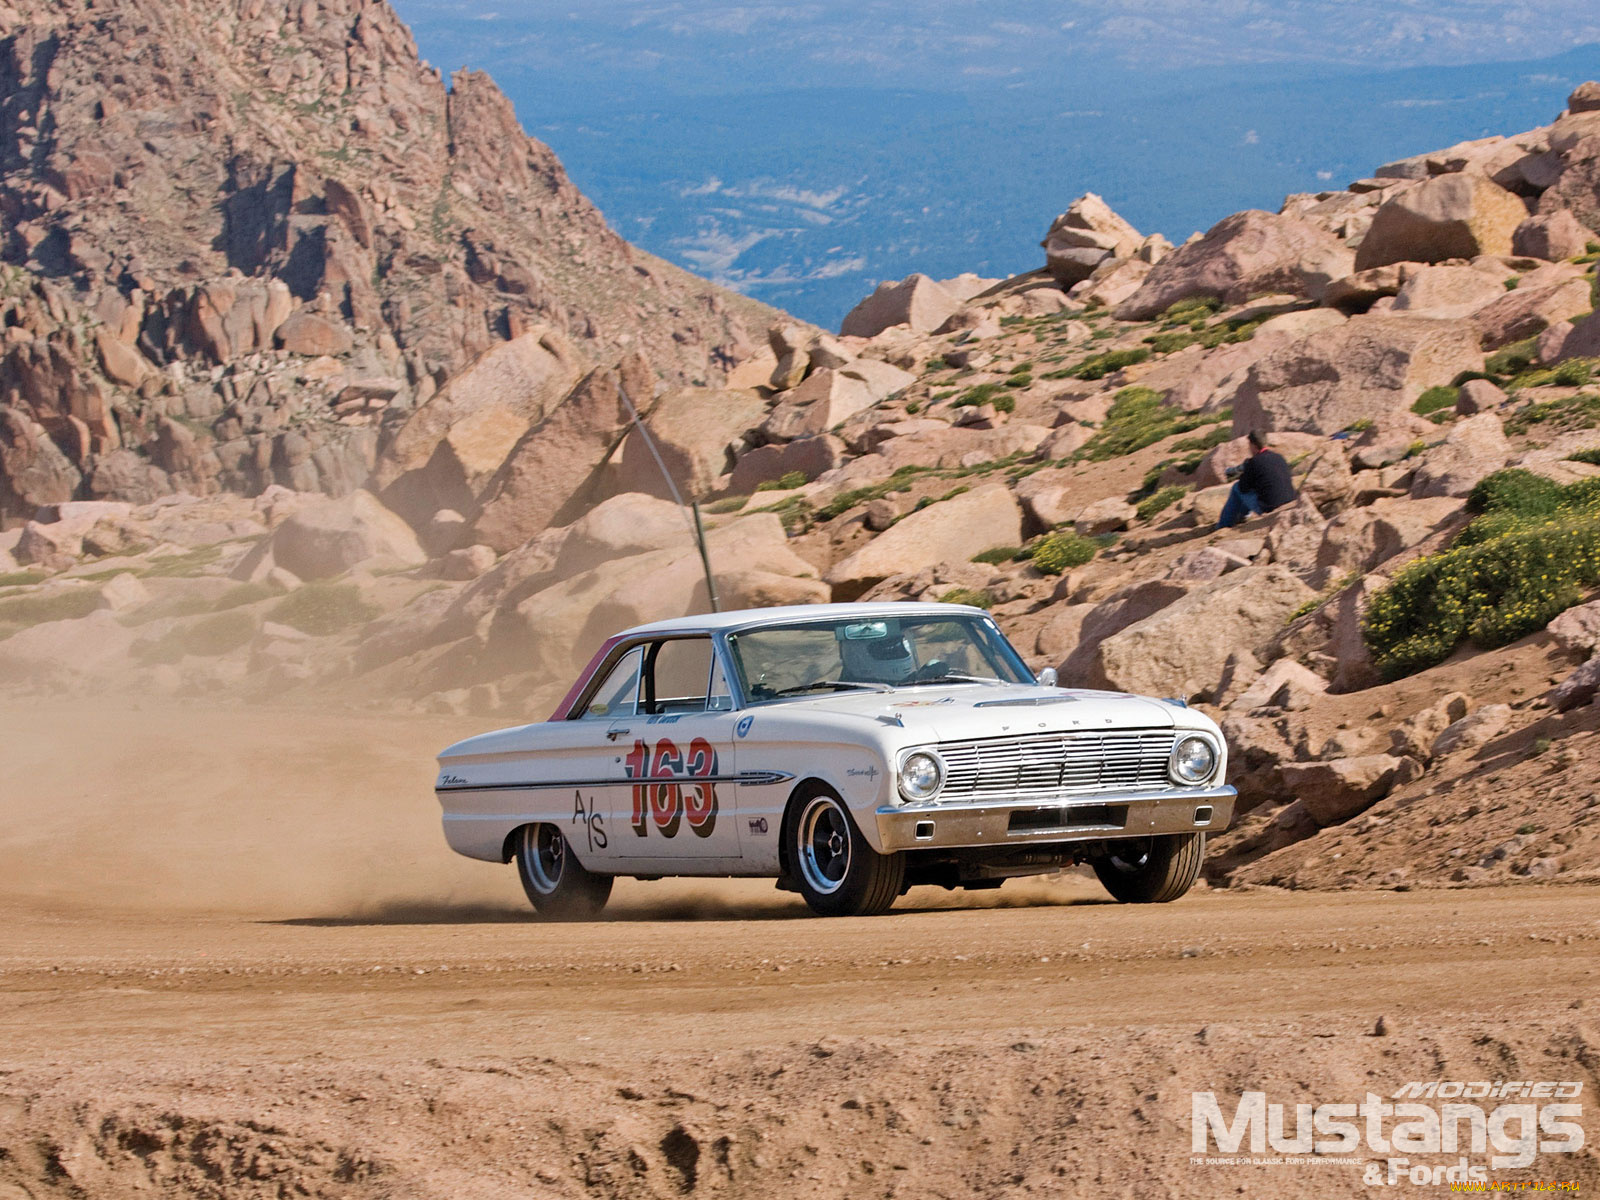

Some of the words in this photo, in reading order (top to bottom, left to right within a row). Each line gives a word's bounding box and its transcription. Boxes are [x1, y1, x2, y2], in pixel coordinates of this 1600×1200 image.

[1002, 718, 1113, 731] FORD
[624, 736, 719, 838] 163
[572, 789, 608, 852] A/S
